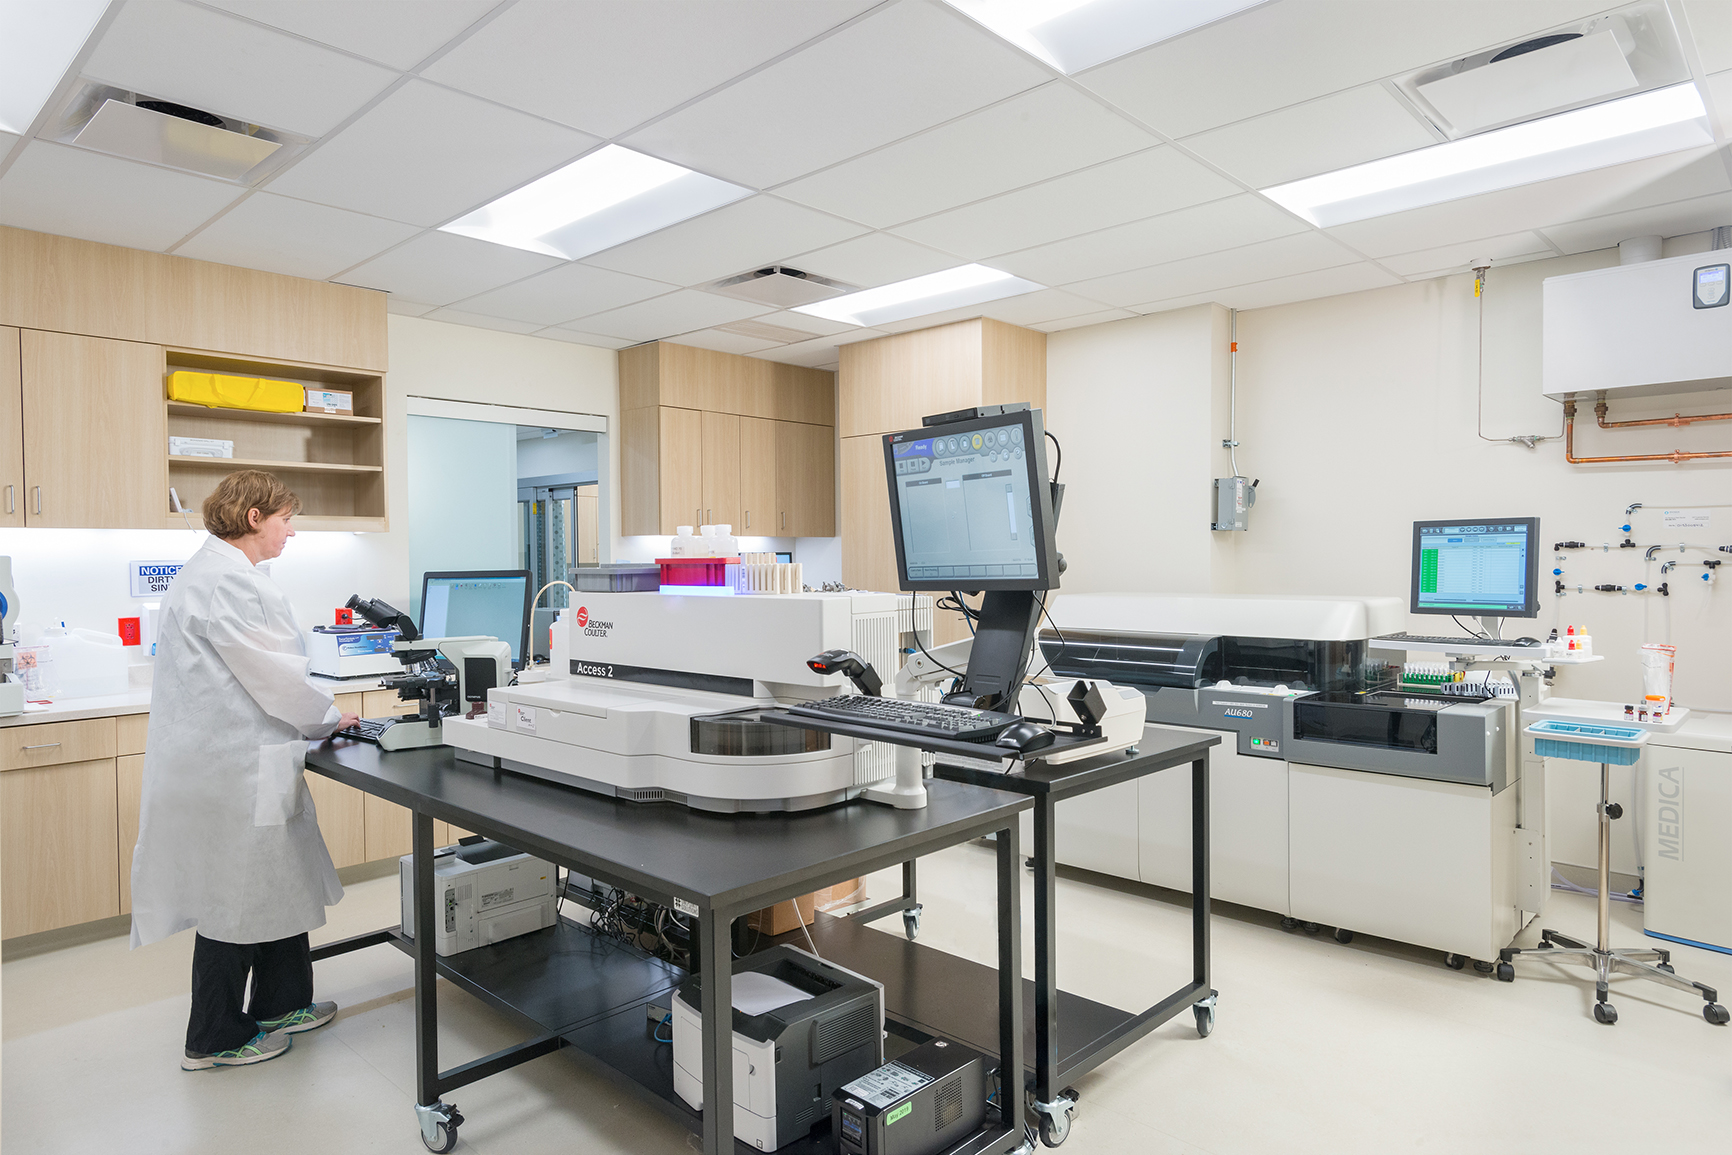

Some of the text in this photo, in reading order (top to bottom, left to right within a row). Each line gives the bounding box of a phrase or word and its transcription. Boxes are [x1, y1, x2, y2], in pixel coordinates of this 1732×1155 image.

[147, 576, 174, 584] DIRT
[150, 583, 170, 592] SIN
[588, 619, 614, 630] BECKMAN
[576, 662, 614, 678] Access 2
[1224, 708, 1253, 718] AU680
[1658, 766, 1680, 861] MEDICA
